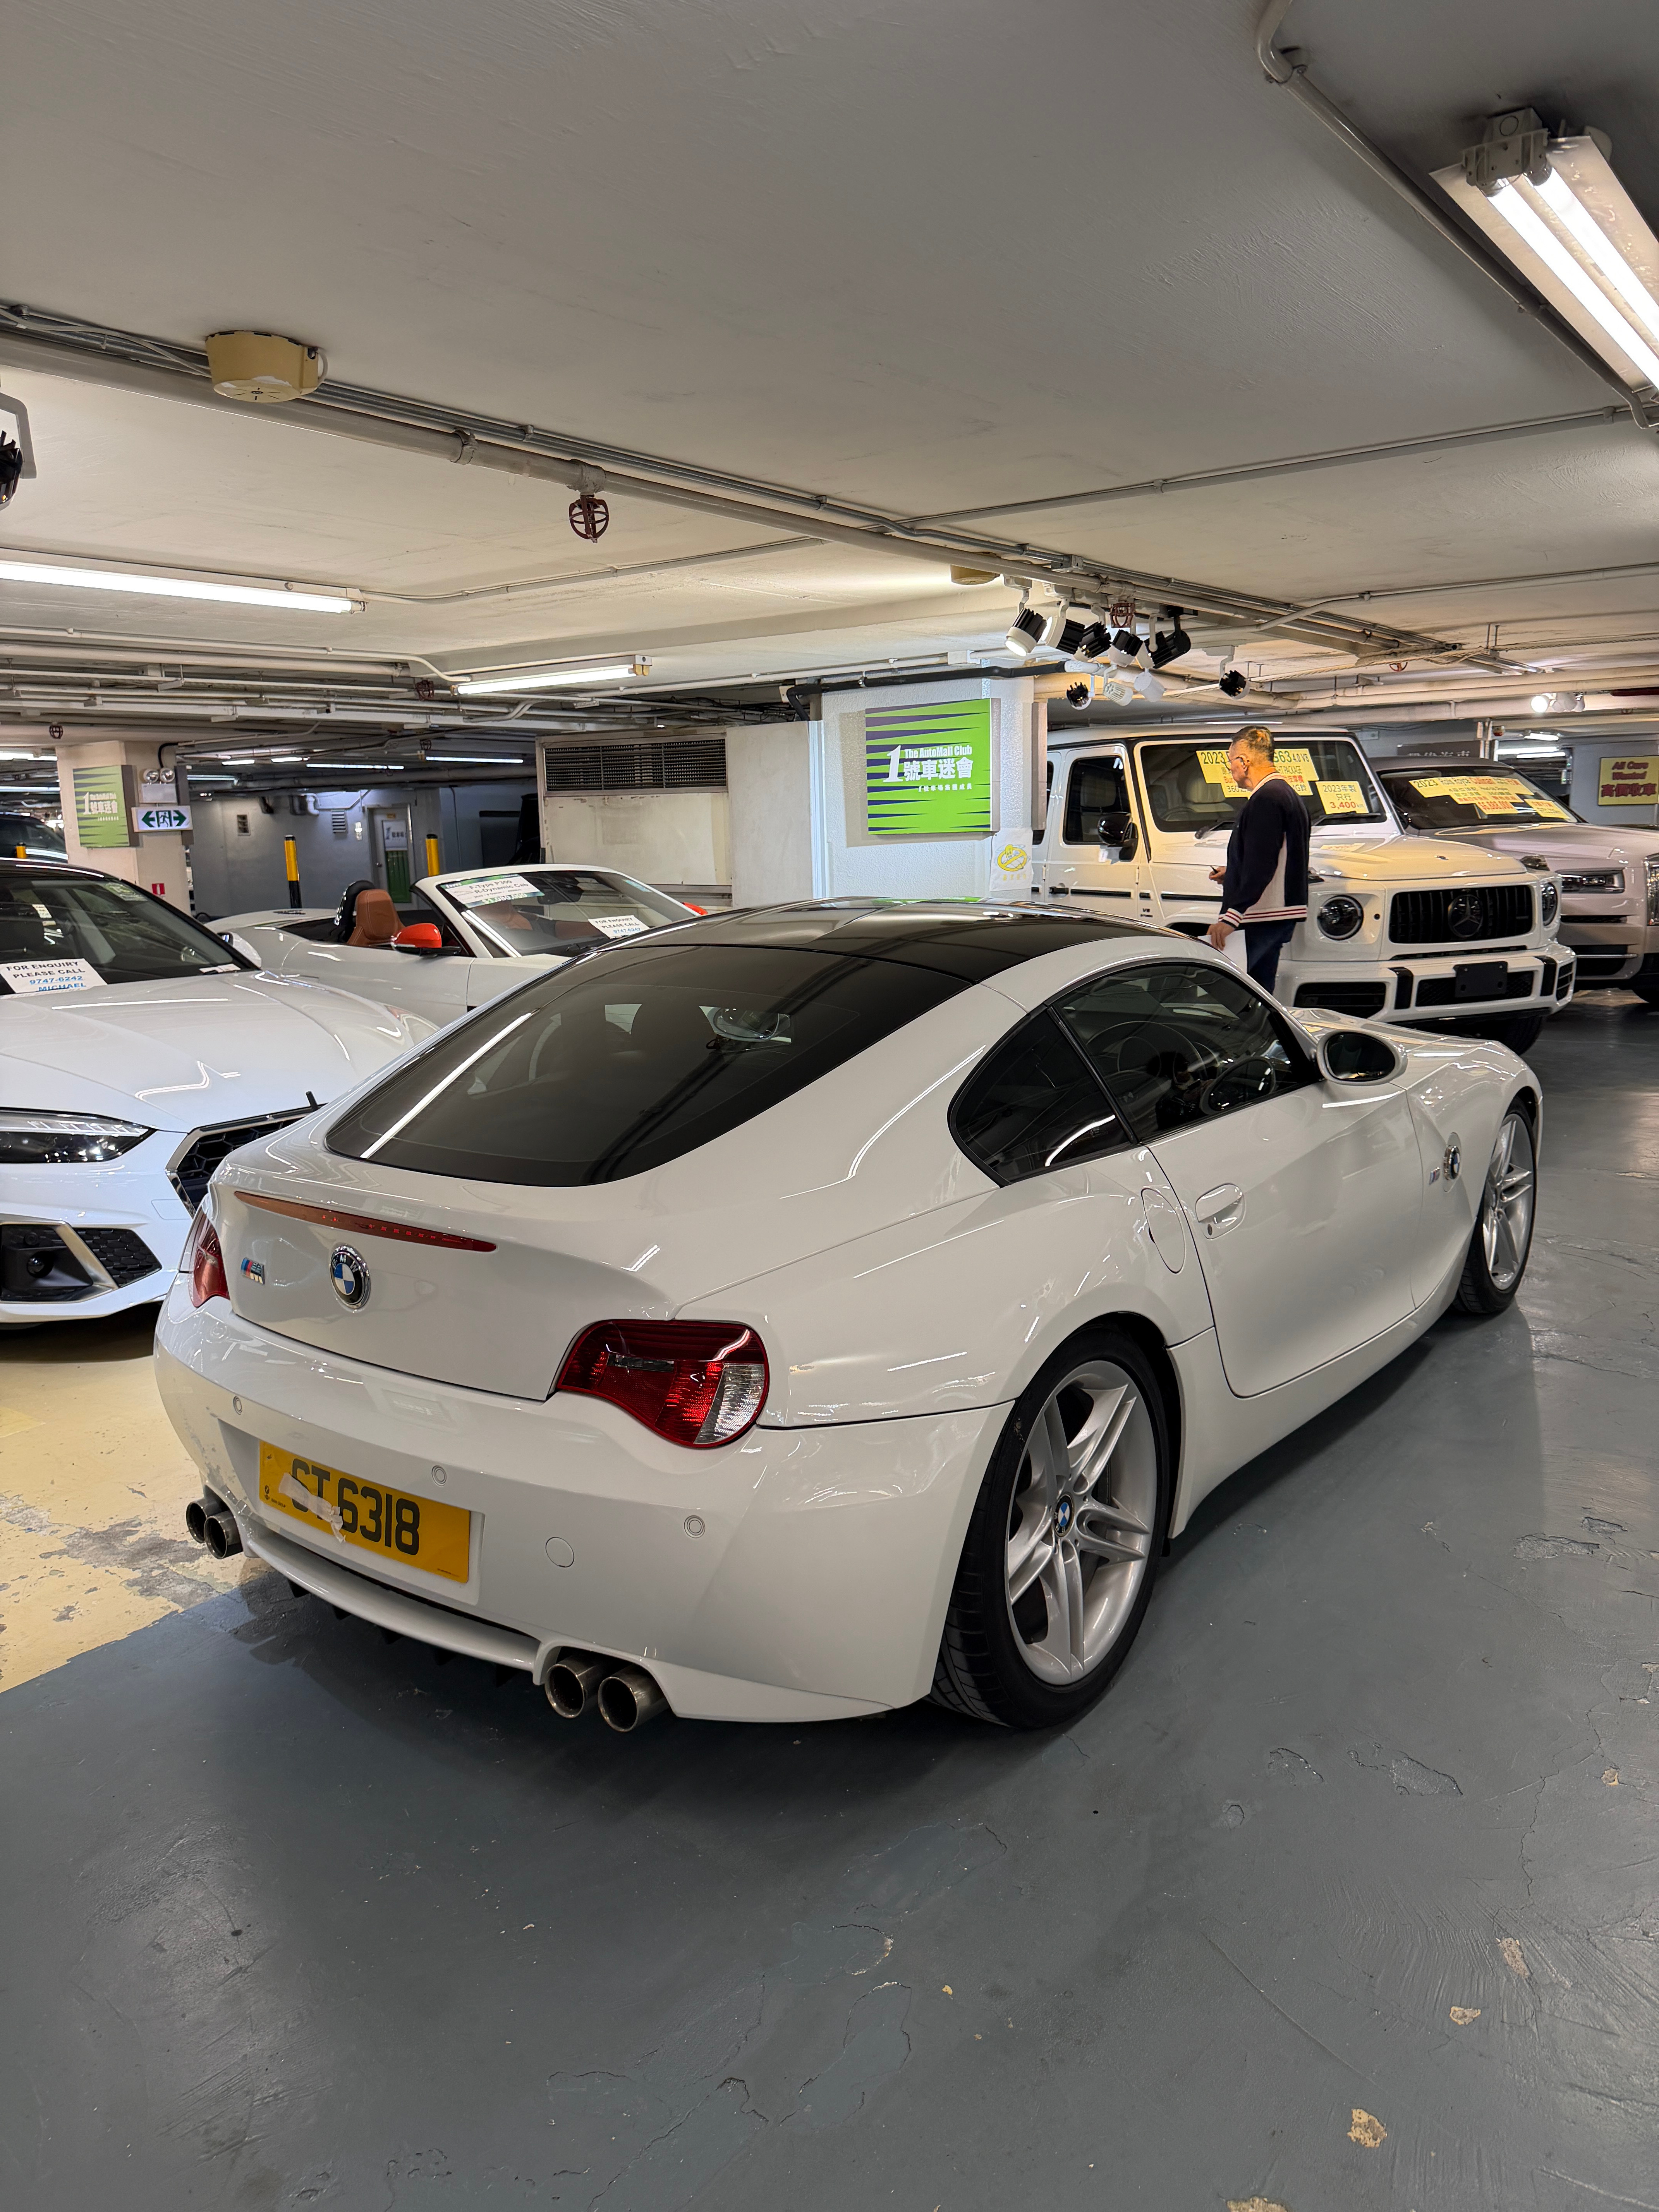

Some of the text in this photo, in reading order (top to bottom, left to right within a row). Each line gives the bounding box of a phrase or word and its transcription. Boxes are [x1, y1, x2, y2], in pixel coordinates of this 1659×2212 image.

[904, 745, 972, 759] The AutoMall Club
[1201, 752, 1225, 764] 2023
[1413, 779, 1439, 788] 2023
[29, 975, 84, 985] 9747-6242
[38, 982, 87, 991] MICHAEL
[337, 1477, 420, 1556] 6318
